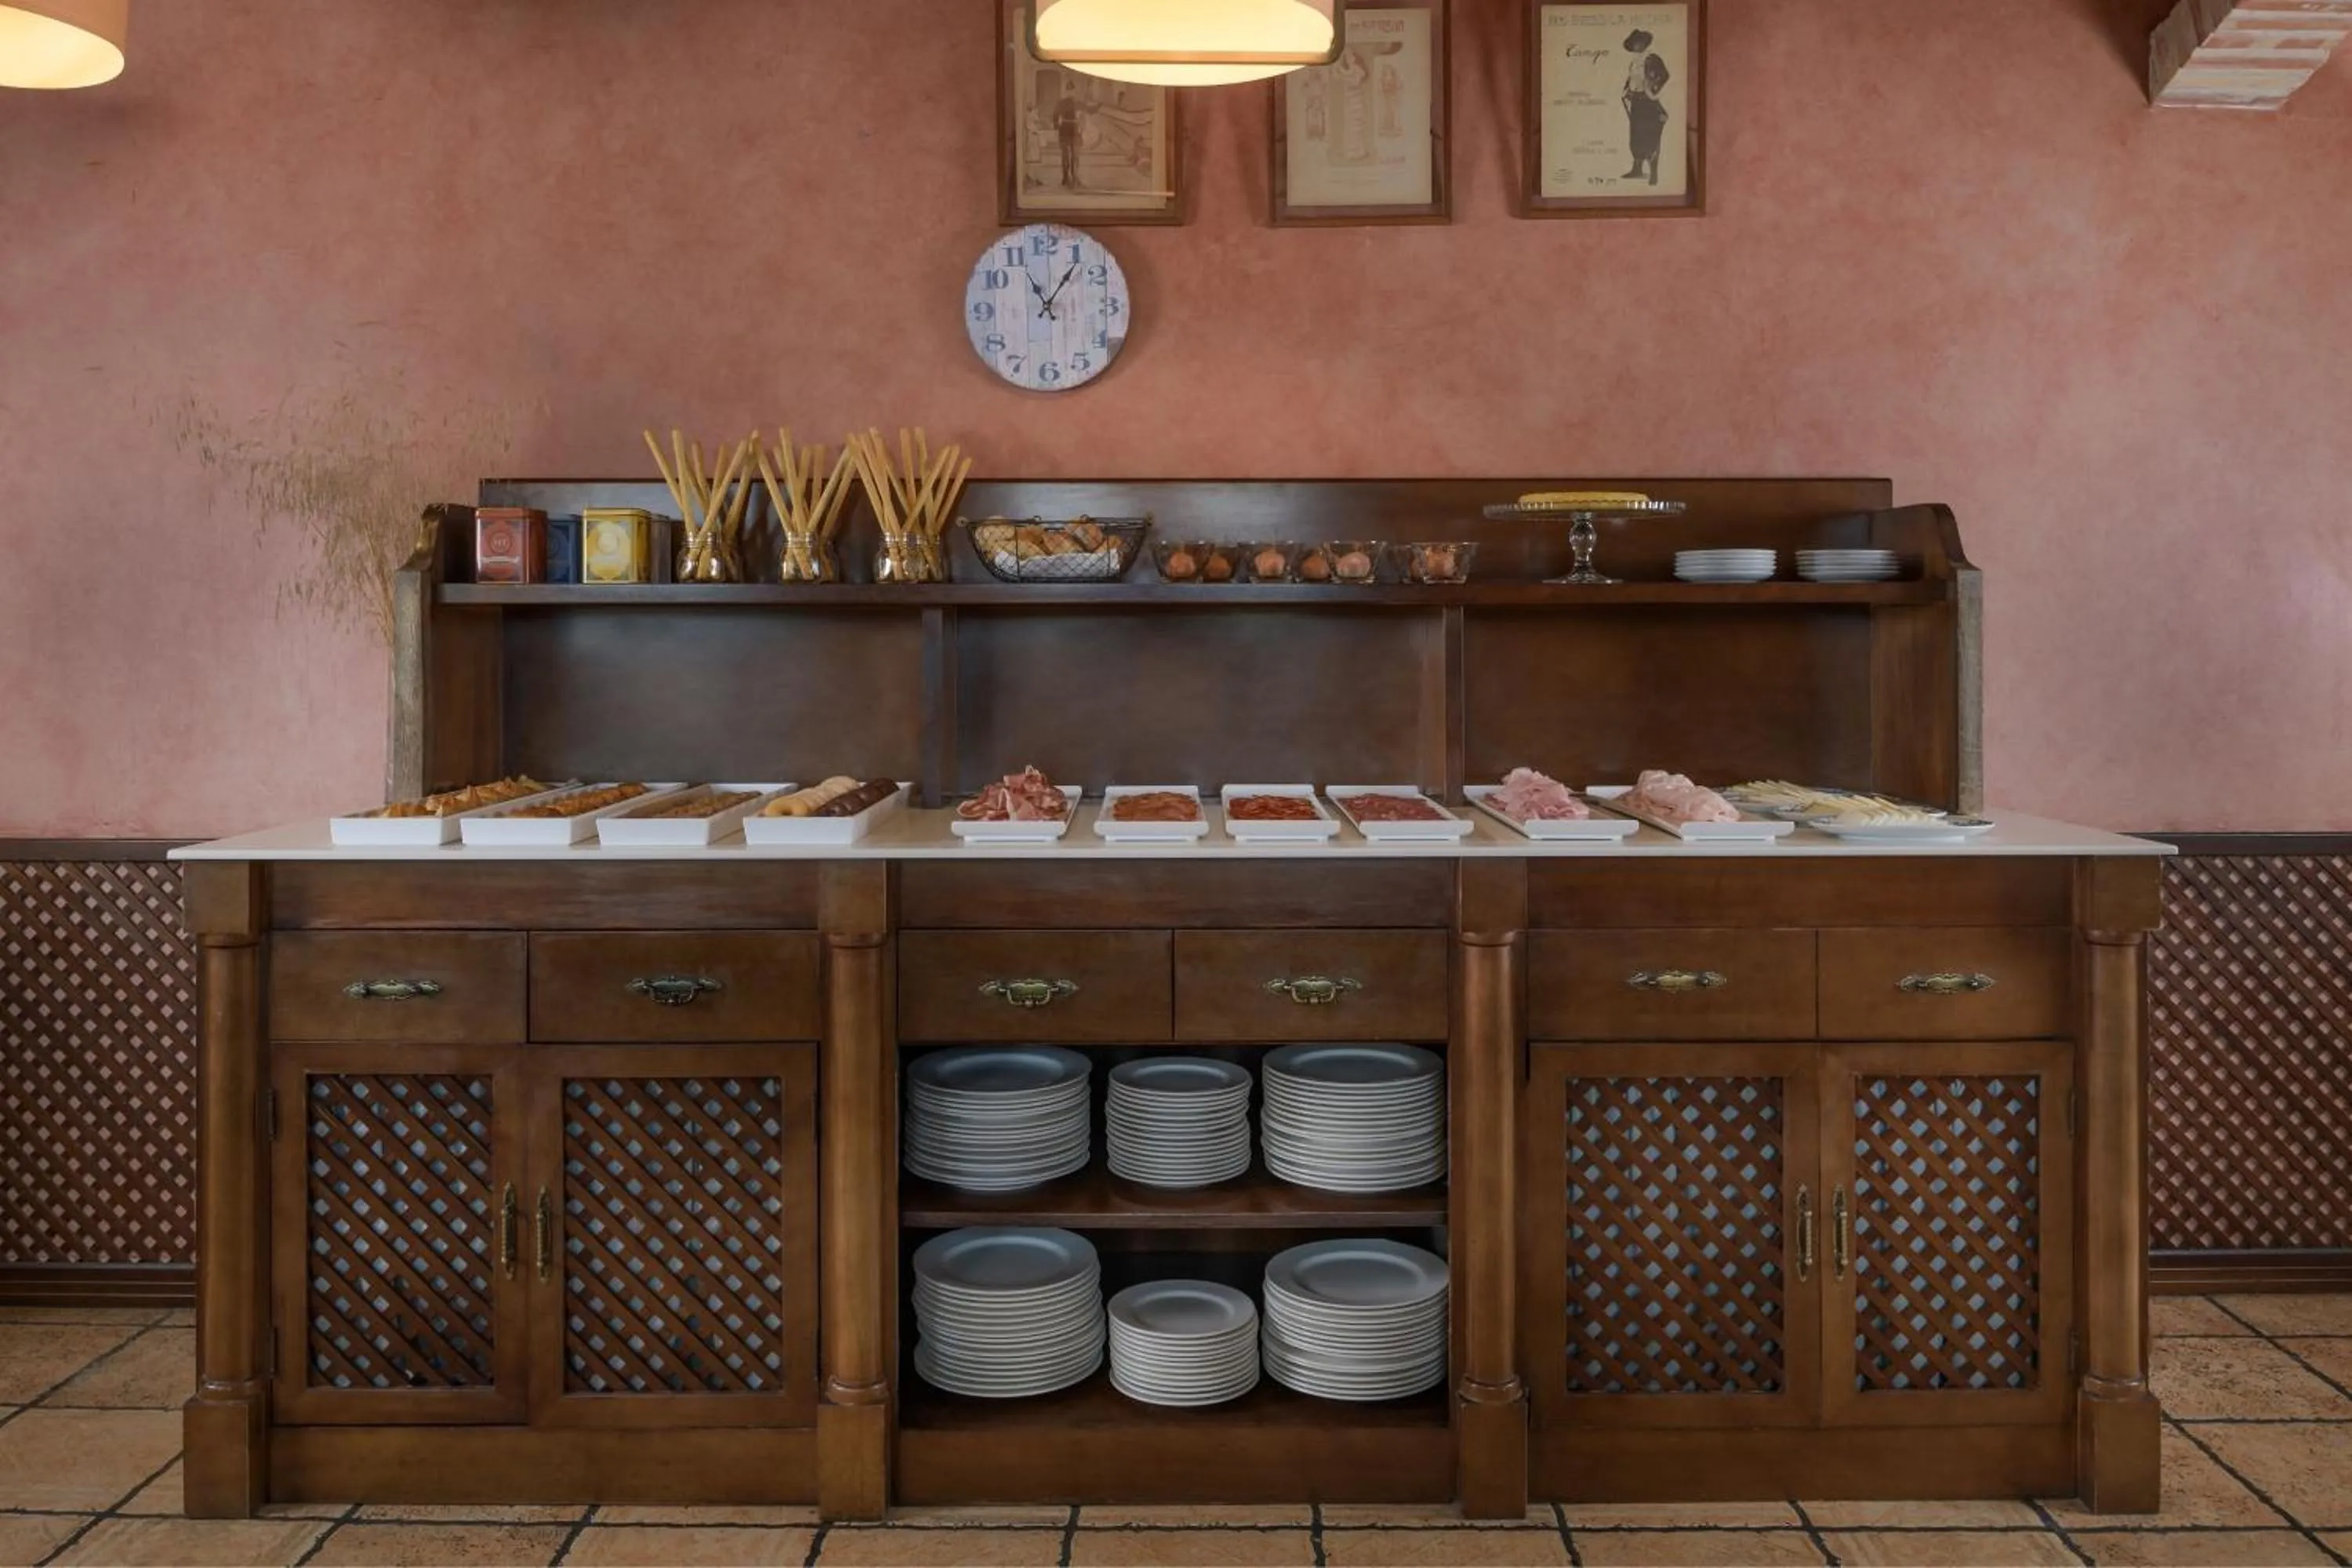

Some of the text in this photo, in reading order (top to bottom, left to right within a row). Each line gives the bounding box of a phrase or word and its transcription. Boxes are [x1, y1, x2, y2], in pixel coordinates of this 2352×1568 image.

[1029, 234, 1058, 256] 12
[1066, 244, 1082, 263] 1
[1001, 246, 1026, 267] 11
[982, 269, 1008, 290] 10
[1087, 265, 1107, 285] 2
[974, 301, 993, 321] 9
[1098, 296, 1120, 316] 3
[986, 333, 1006, 352] 8
[1007, 354, 1027, 373] 7
[1070, 352, 1091, 371] 5
[1039, 362, 1060, 382] 6
